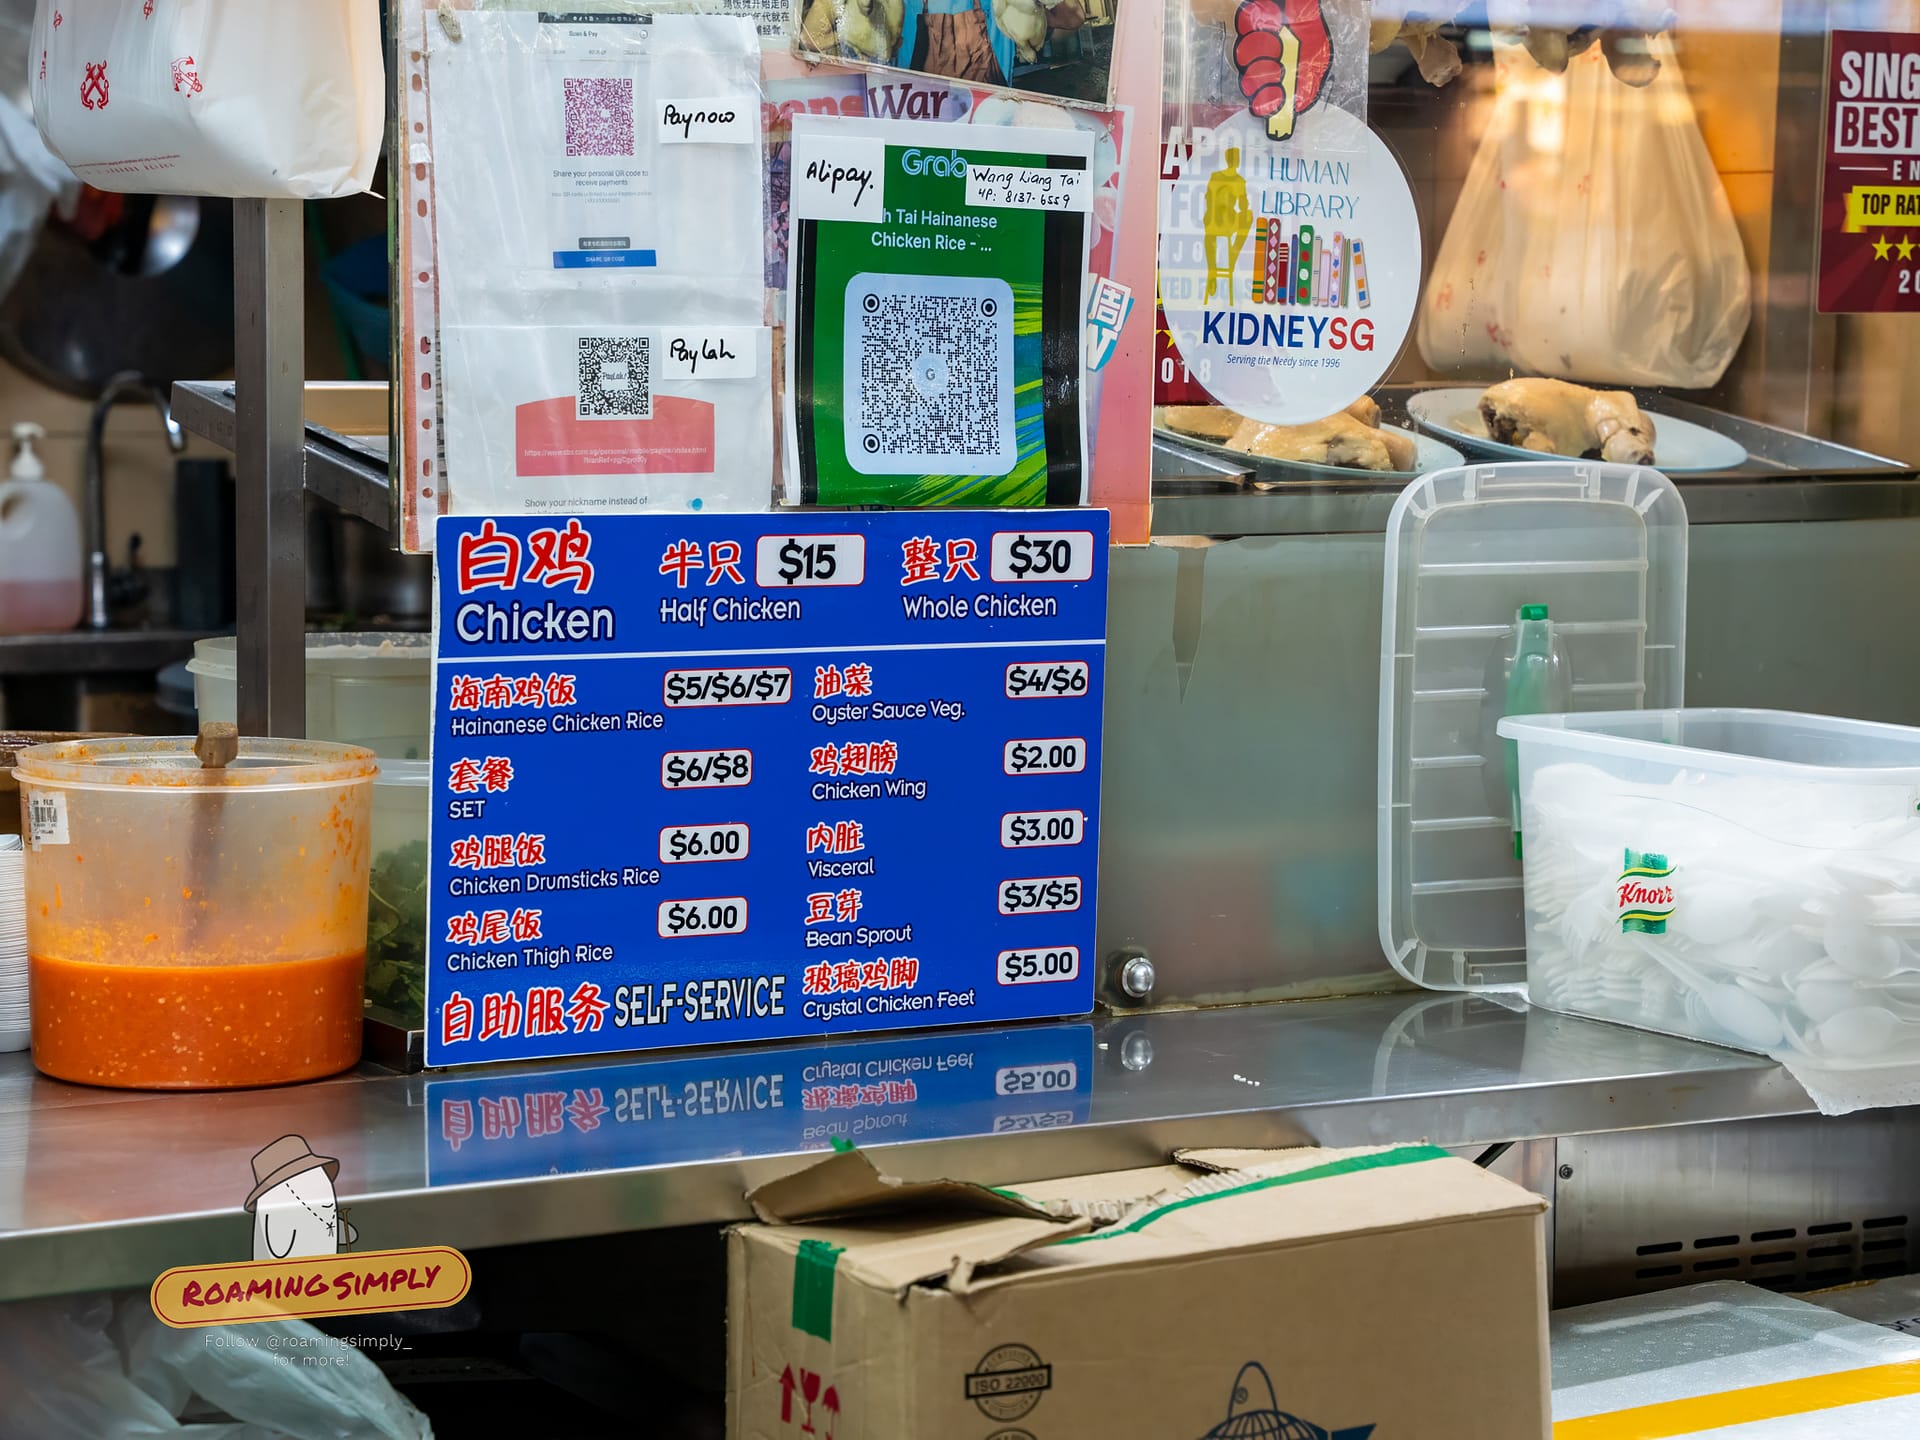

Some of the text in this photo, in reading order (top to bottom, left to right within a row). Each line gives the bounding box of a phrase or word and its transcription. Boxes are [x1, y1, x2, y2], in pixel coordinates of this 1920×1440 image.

[1839, 51, 1920, 99] SING
[868, 83, 948, 119] War
[1840, 105, 1918, 149] BEST
[553, 169, 572, 178] Share
[573, 170, 587, 179] your
[588, 170, 614, 179] personal
[901, 148, 967, 178] Grab
[1269, 157, 1350, 185] HUMAN
[599, 179, 629, 187] payments
[1060, 172, 1081, 187] Tai
[896, 208, 918, 225] Tai
[921, 210, 998, 229] Hainanese
[1261, 190, 1360, 219] LIBRARY
[1862, 194, 1891, 215] TOP
[871, 231, 931, 249] Chicken
[935, 234, 966, 250] Rice
[1203, 311, 1375, 351] KIDNEYSG
[1226, 353, 1341, 368] Serving the Needy since 1996
[525, 496, 648, 509] Show your nickname instead of
[658, 539, 745, 588] 半只
[778, 538, 837, 585] $15
[901, 535, 981, 587] 整只
[1009, 534, 1072, 579] $30
[456, 602, 613, 642] Chicken
[660, 597, 801, 628] Half Chicken
[902, 594, 1057, 620] Whole Chicken
[450, 672, 578, 711] 海南鸡饭
[666, 670, 791, 705] $5/$6/$7
[813, 663, 873, 700] 油菜
[1008, 665, 1087, 695] $4/$6
[452, 711, 664, 736] Hainanese Chicken Rice
[812, 700, 966, 726] Oyster Sauce Veg.
[666, 752, 749, 787] $6/$8
[808, 740, 898, 777] 鸡翅膀
[1010, 743, 1077, 773] $2.00
[449, 756, 514, 794] 套餐
[811, 780, 927, 801] Chicken Wing
[449, 800, 486, 819] SET
[669, 829, 740, 860] $6.00
[806, 820, 865, 854] 内脏
[1010, 815, 1075, 845] $3.00
[448, 832, 547, 871] 鸡腿饭
[449, 868, 661, 896] Chicken Drumsticks Rice
[807, 858, 875, 878] Visceral
[804, 888, 863, 926] 豆芽
[1003, 880, 1078, 912] $3/$5
[1617, 882, 1674, 908] Knorr
[446, 907, 543, 946] 鸡尾饭
[667, 903, 738, 934] $6.00
[805, 925, 912, 948] Bean Sprout
[447, 944, 614, 972] Chicken Thigh Rice
[1004, 951, 1073, 982] $5.00
[802, 957, 919, 996] 玻璃鸡脚
[442, 981, 610, 1046] 自助服务
[612, 975, 787, 1028] SELF-SERVICE
[802, 989, 975, 1021] Crystal Chicken Feet
[974, 1378, 1001, 1394] ISO
